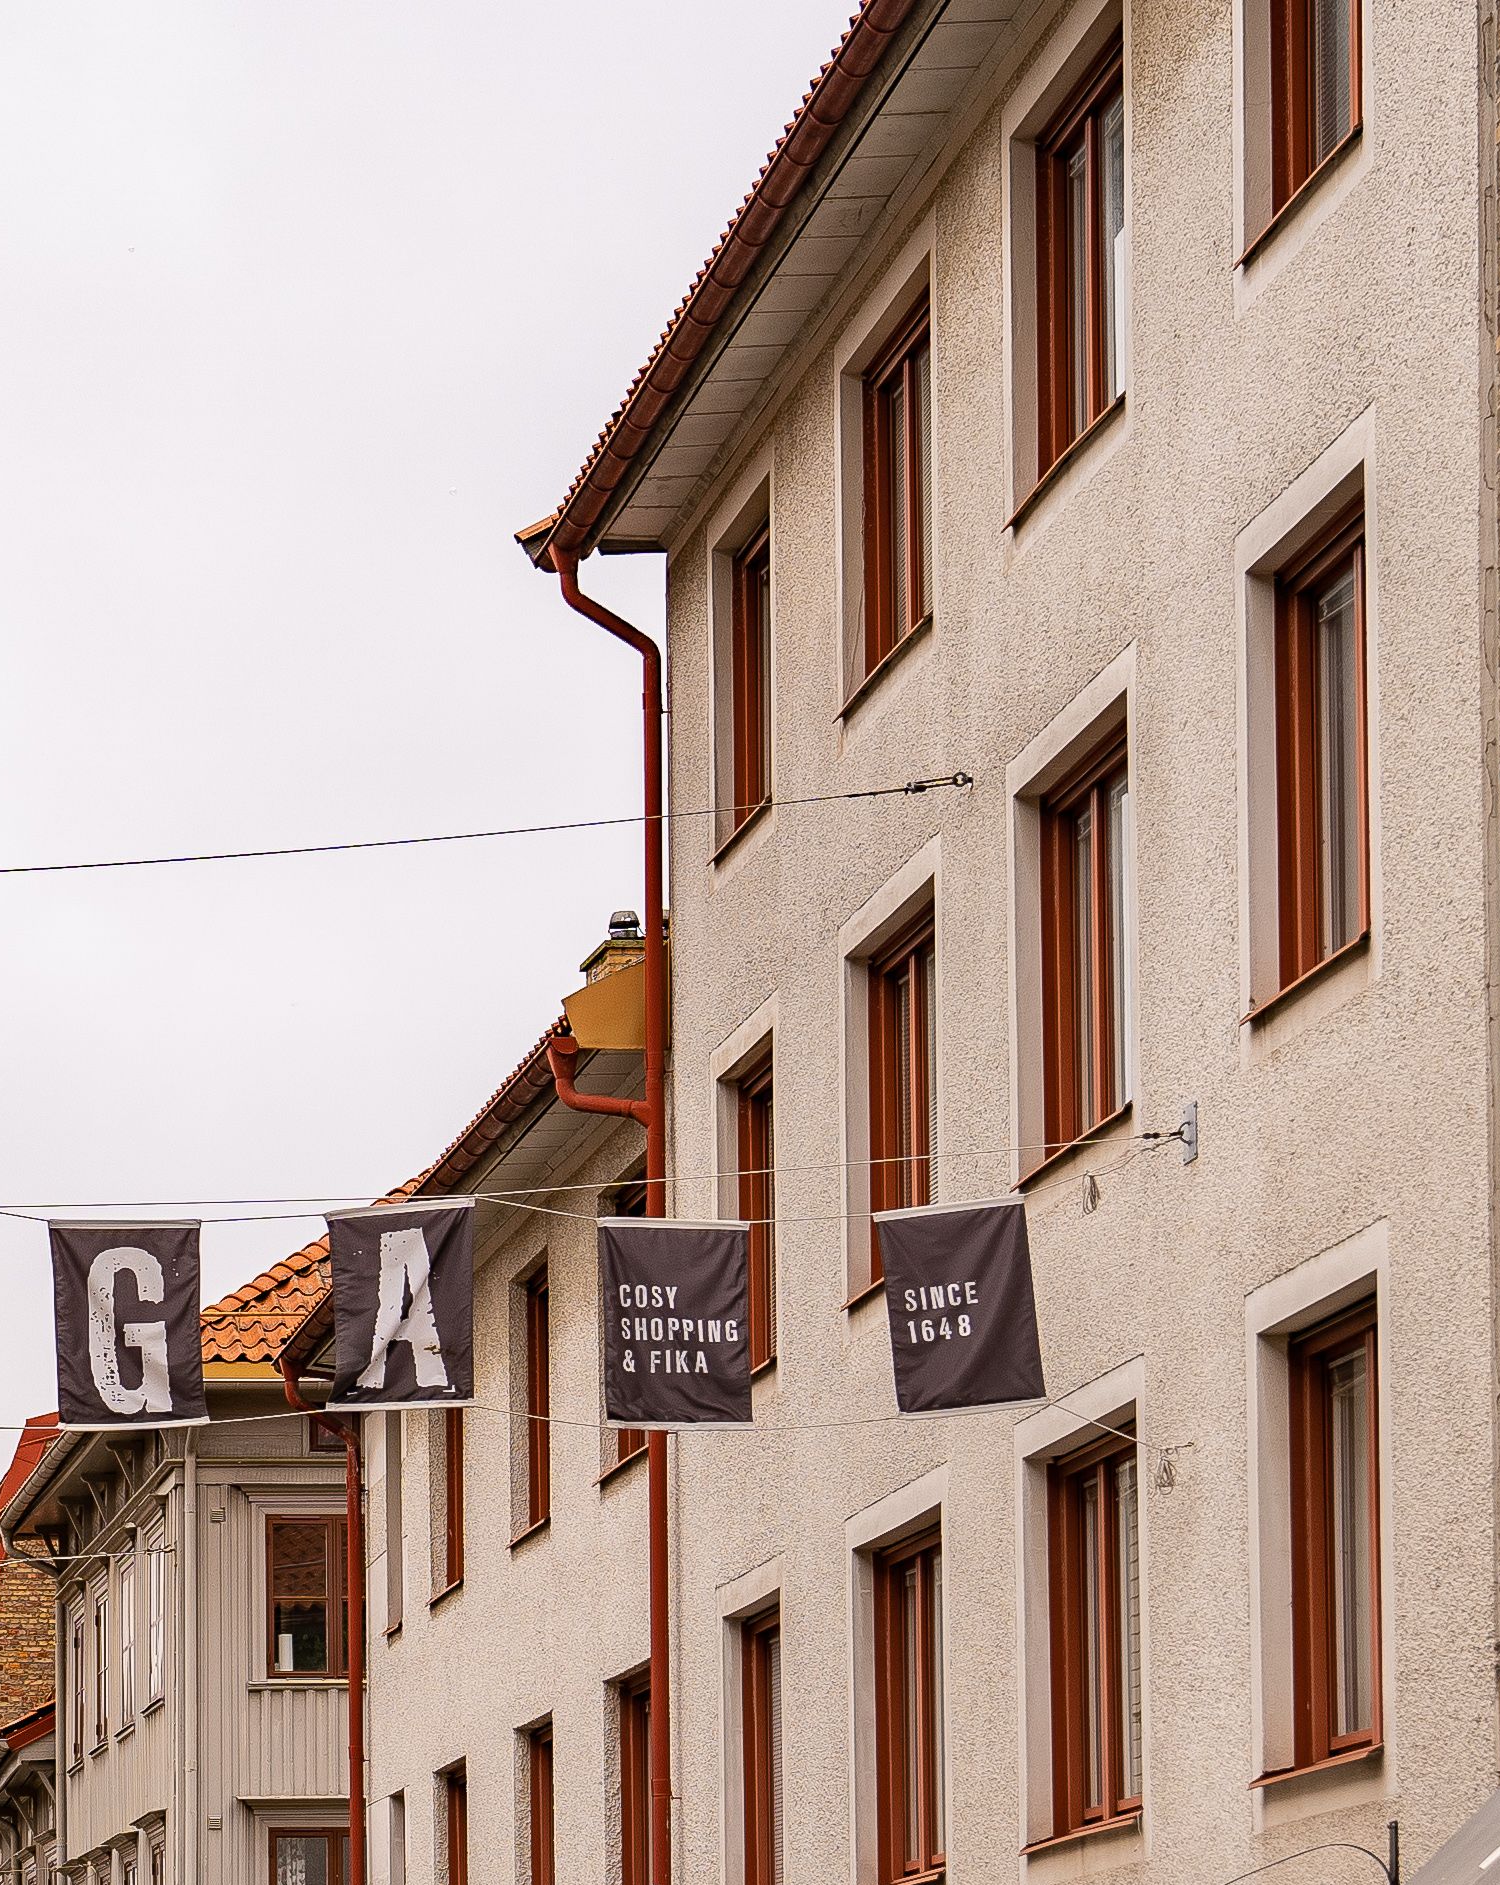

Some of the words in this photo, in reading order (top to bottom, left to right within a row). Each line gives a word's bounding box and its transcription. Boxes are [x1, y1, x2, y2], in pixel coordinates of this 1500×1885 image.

[618, 1284, 677, 1312] COSY
[902, 1279, 980, 1313] SINCE
[620, 1315, 741, 1346] SHOPPING
[906, 1314, 975, 1345] 1648
[622, 1348, 638, 1374] &
[648, 1348, 710, 1376] FIKA
